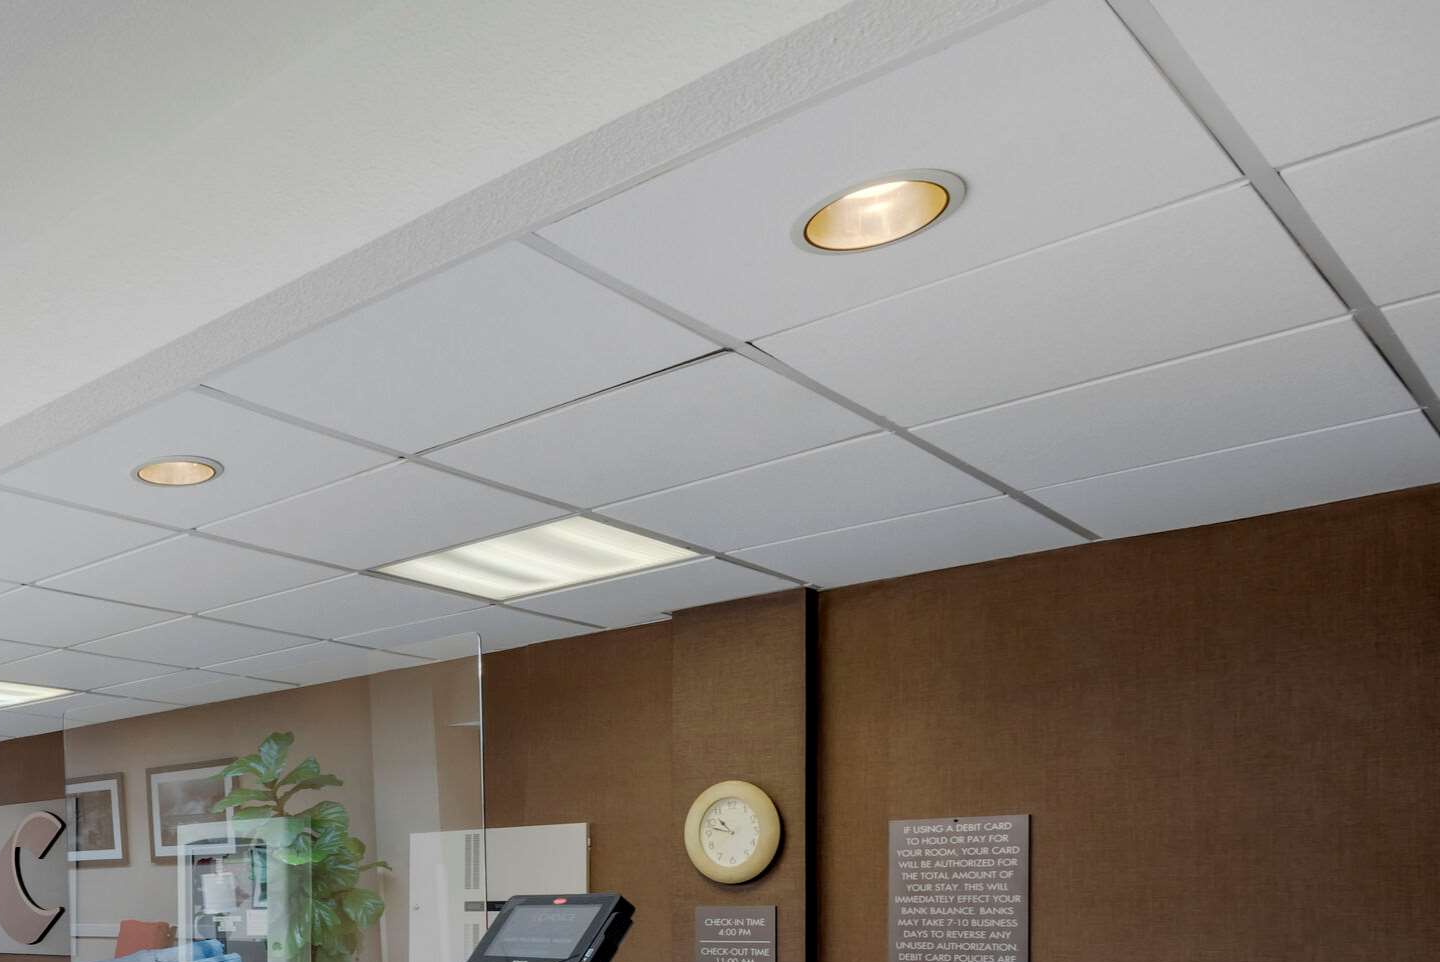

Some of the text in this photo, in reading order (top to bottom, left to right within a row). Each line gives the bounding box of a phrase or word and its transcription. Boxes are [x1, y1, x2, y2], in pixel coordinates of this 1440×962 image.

[956, 824, 980, 832] DEBIT
[704, 918, 765, 926] CHECK-IN TIME
[701, 948, 749, 956] CHECK-OUT
